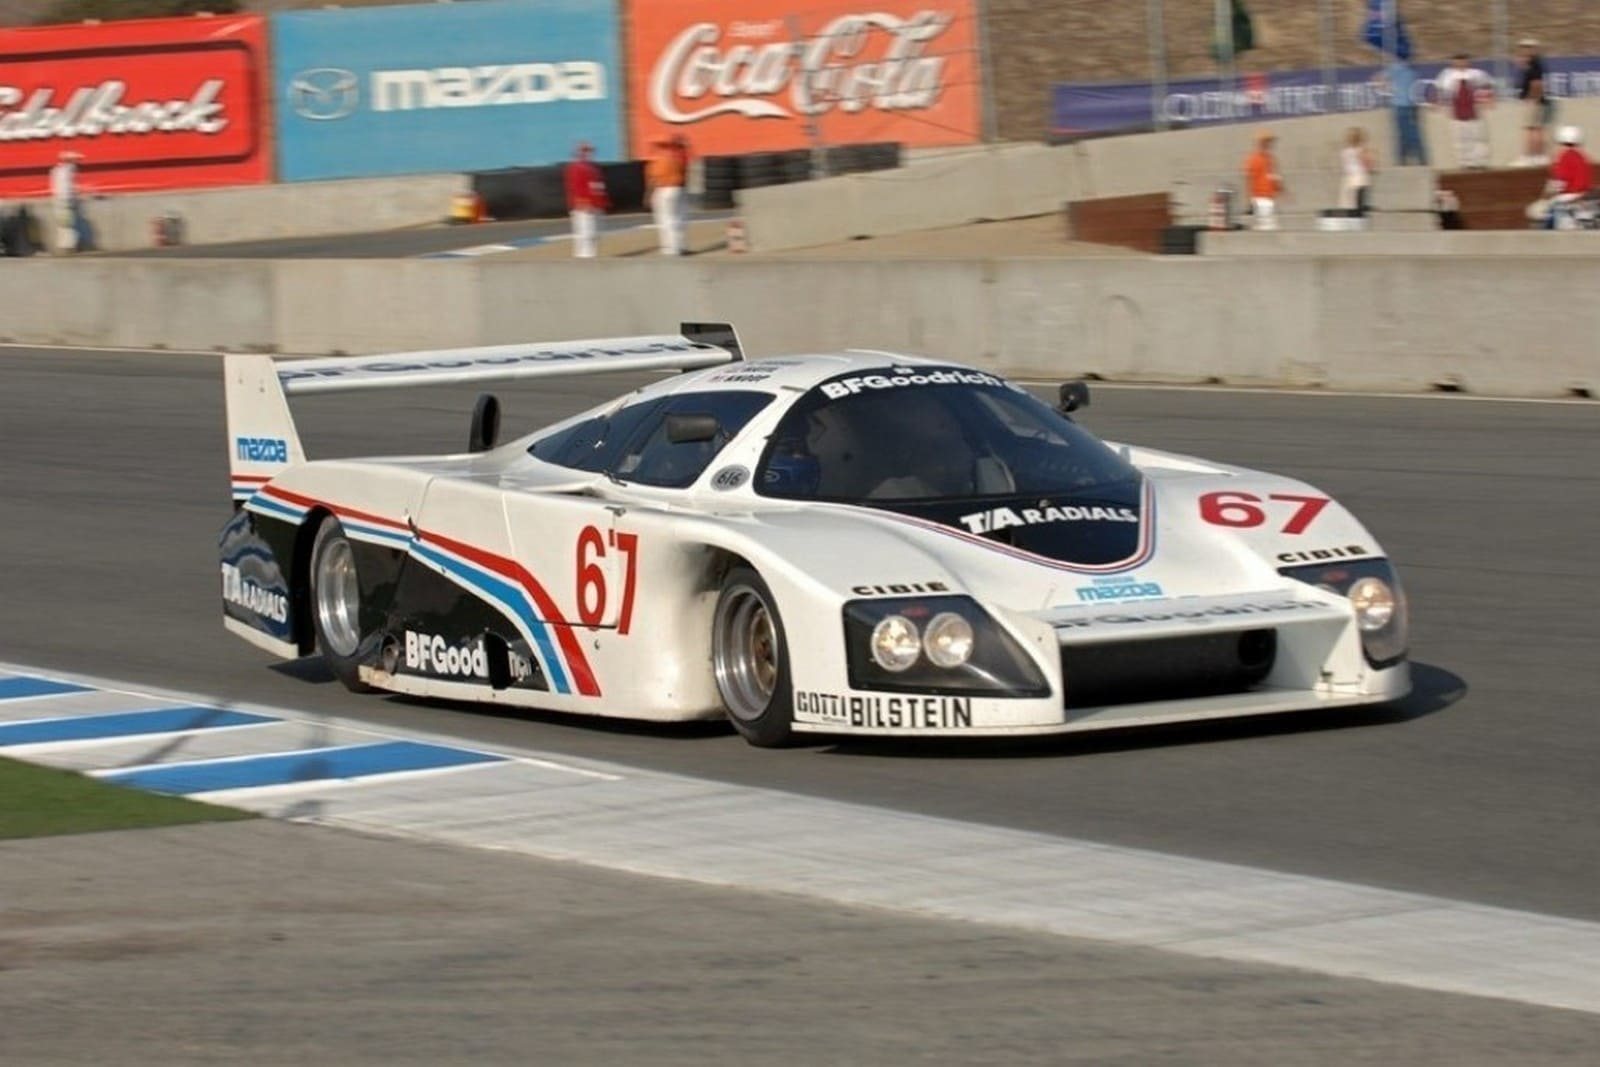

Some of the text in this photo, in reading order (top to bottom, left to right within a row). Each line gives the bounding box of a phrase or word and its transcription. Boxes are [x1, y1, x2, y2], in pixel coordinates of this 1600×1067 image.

[370, 60, 608, 111] mazda
[819, 370, 1003, 400] BFGoodrich
[236, 437, 288, 463] mazda
[960, 506, 1139, 535] T/A RADIALS
[1198, 491, 1331, 534] 67
[576, 525, 638, 635] 67
[1076, 583, 1163, 601] mazda
[242, 581, 288, 624] RADIALS
[796, 691, 847, 717] GOTTI
[850, 697, 973, 728] BILSTEIN
